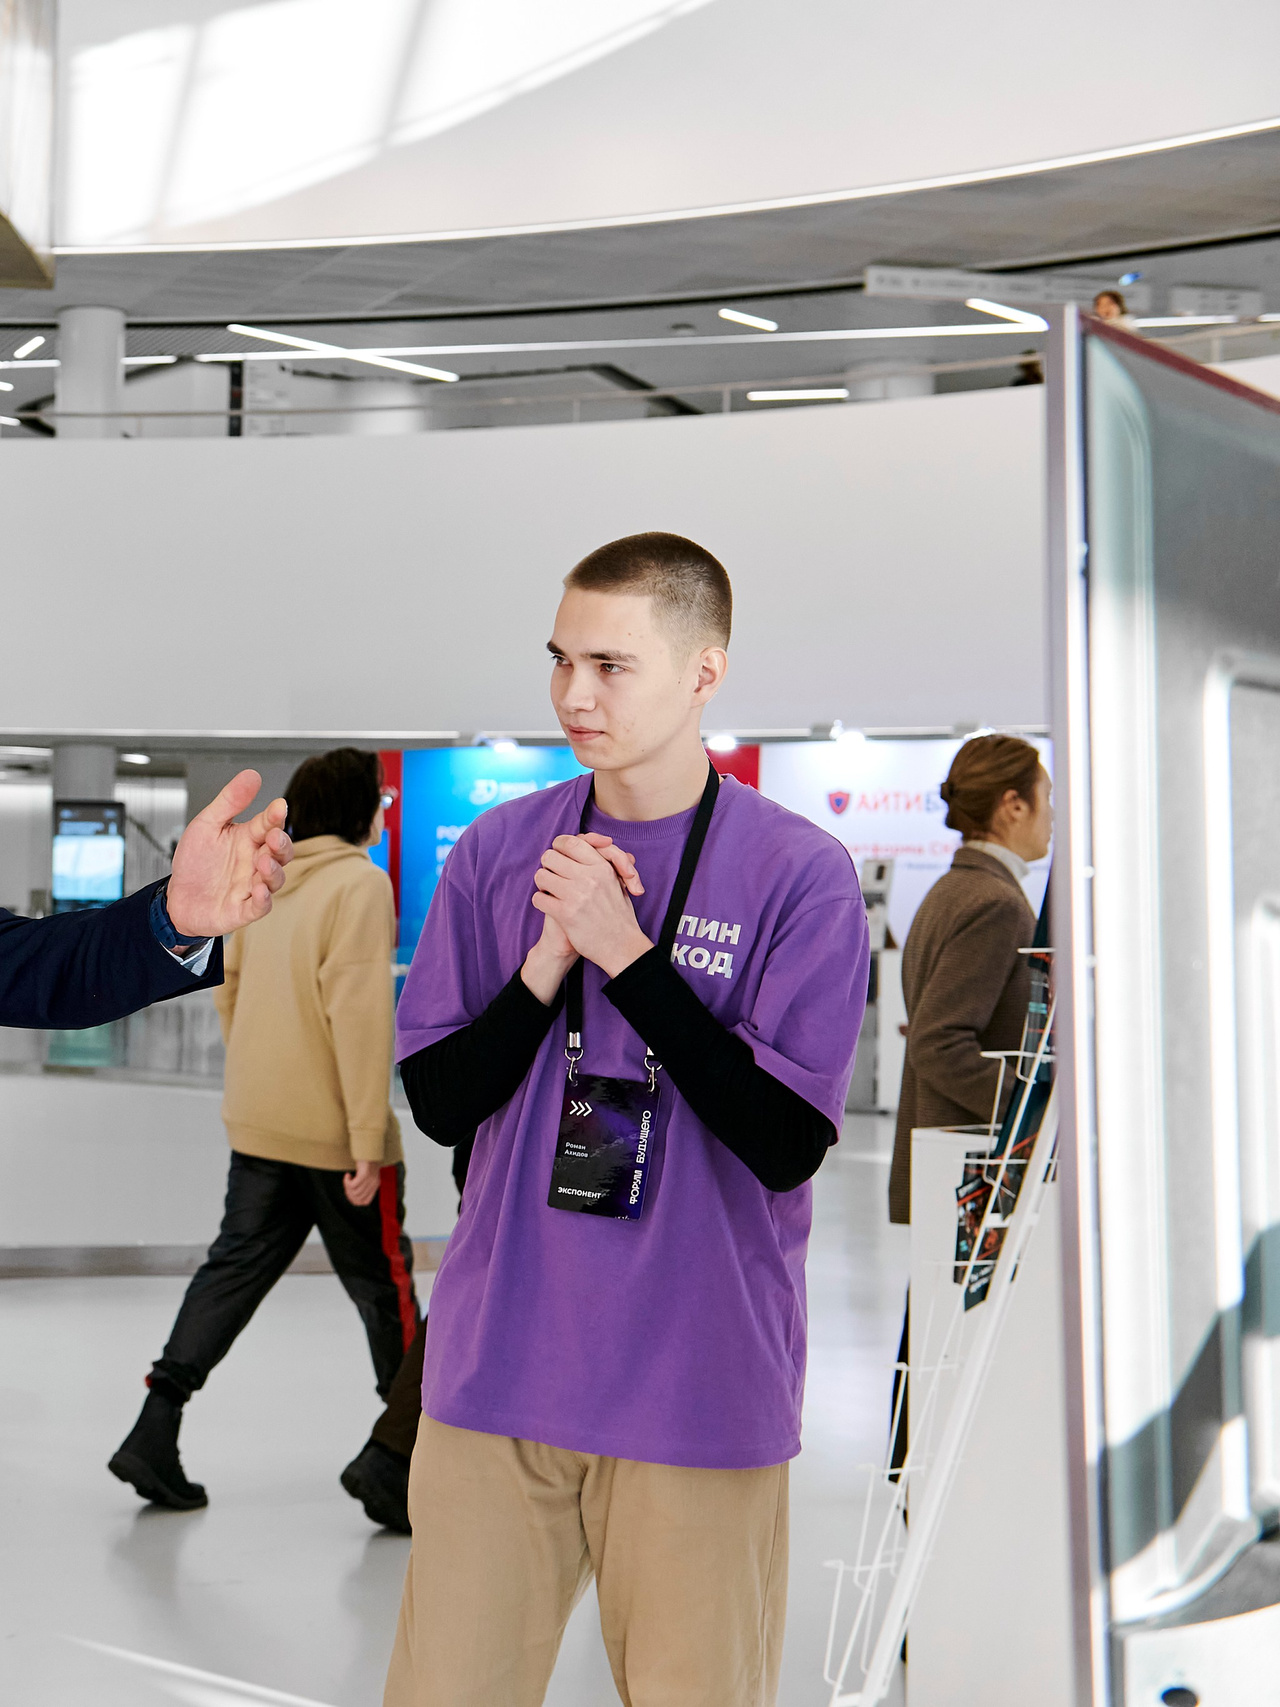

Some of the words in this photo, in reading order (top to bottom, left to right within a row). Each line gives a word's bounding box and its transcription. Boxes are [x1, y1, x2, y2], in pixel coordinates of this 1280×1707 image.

[676, 914, 741, 945] ПИН
[670, 942, 734, 979] КОД
[565, 1142, 586, 1150] Роман
[557, 1186, 602, 1199] ЭКСПОНЕНТ
[629, 1169, 643, 1204] ФОРУМ
